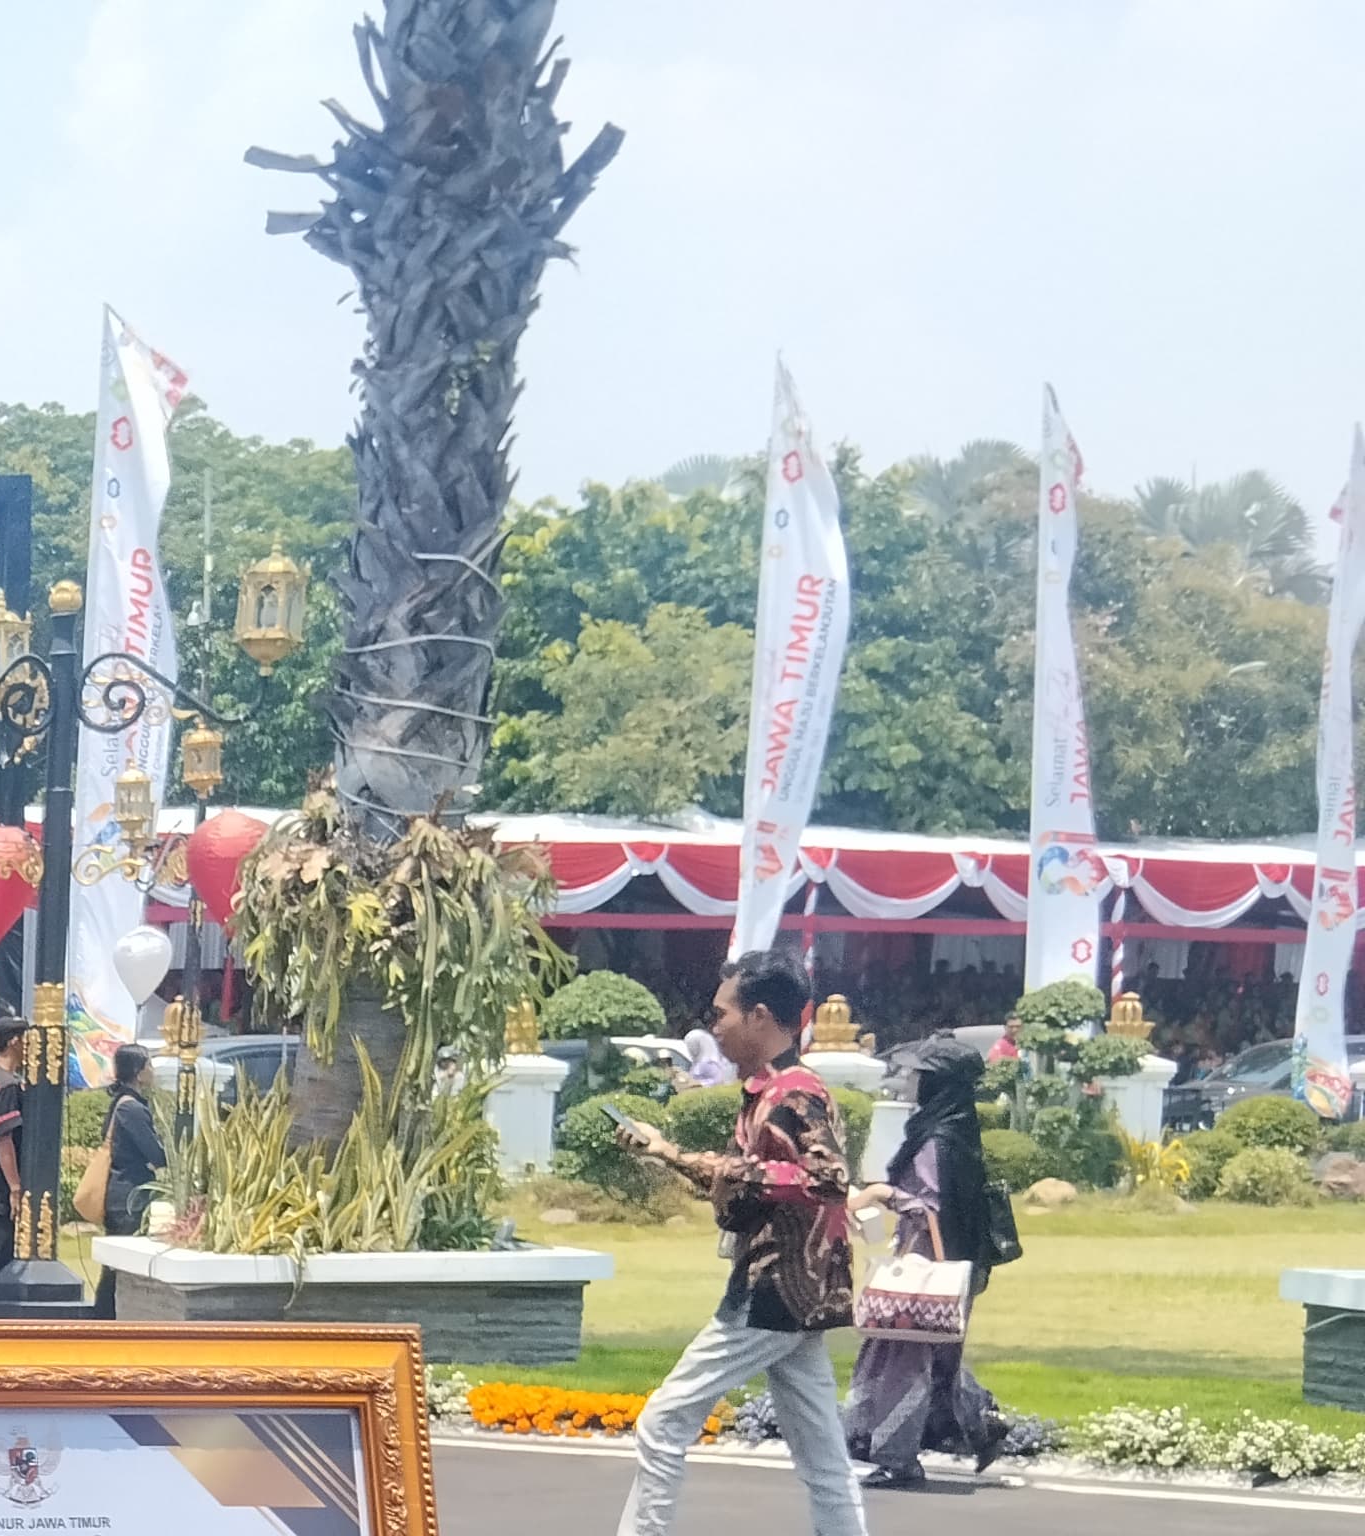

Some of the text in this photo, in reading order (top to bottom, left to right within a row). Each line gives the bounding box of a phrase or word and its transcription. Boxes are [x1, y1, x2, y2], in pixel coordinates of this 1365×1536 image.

[760, 699, 799, 791] JAWA
[781, 573, 825, 685] TIMUR
[28, 1516, 66, 1530] JAWA
[69, 1516, 111, 1529] TIMUR
